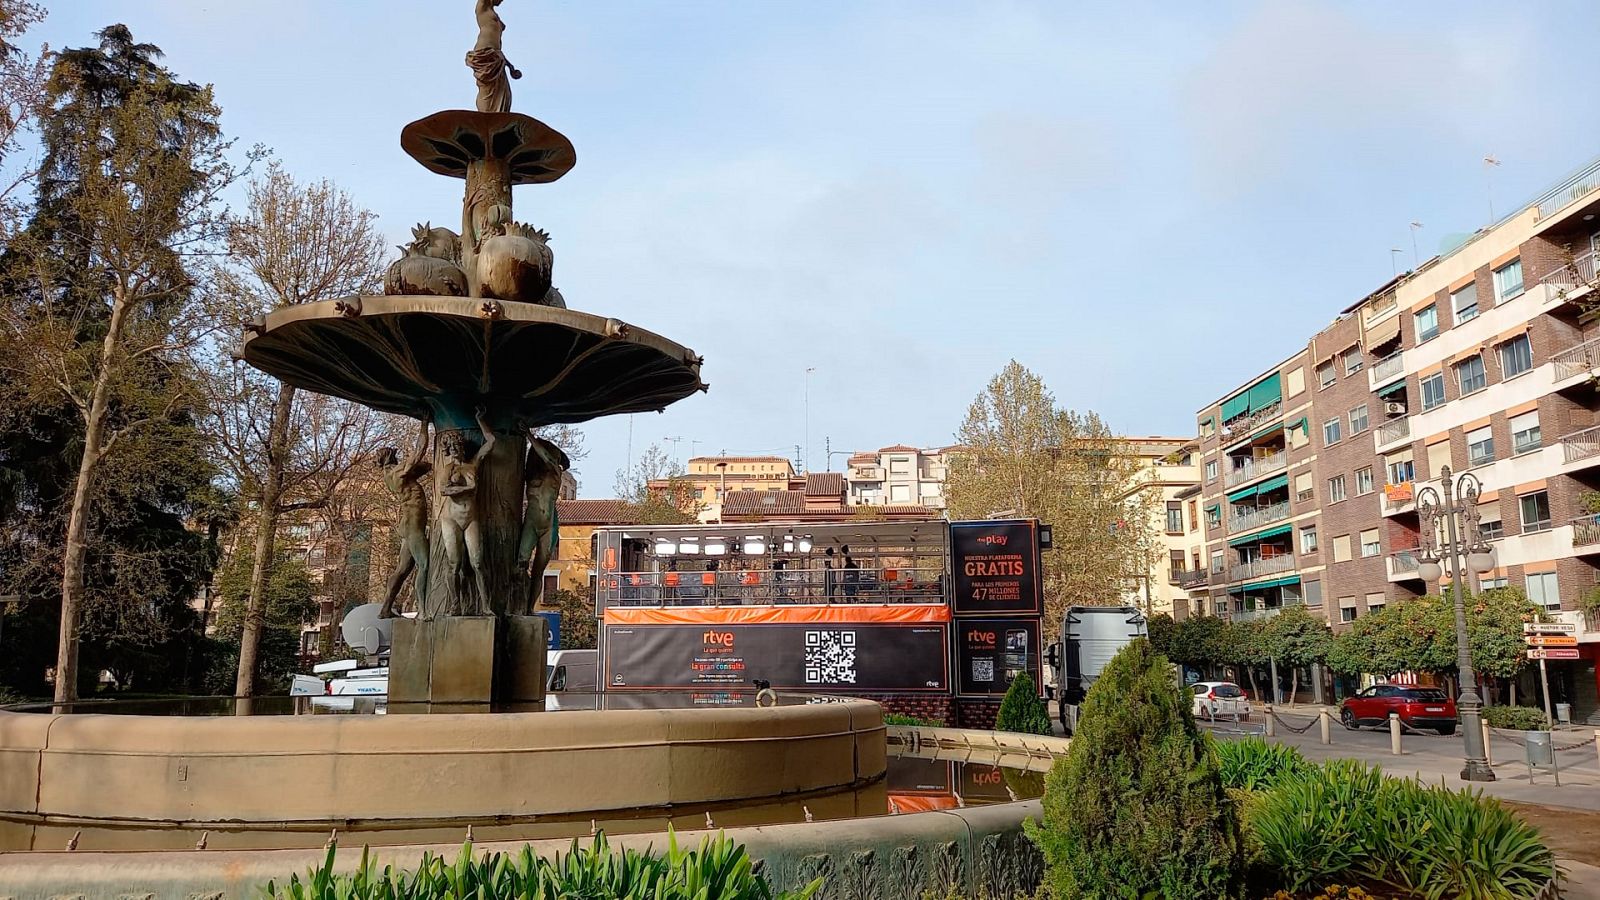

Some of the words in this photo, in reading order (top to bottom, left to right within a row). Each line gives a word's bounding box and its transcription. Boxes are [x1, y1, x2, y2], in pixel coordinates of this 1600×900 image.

[986, 535, 1008, 546] play
[964, 560, 1024, 577] GRATIS
[971, 588, 988, 601] 47
[703, 630, 734, 647] rtve
[968, 630, 996, 644] rtve
[715, 662, 745, 670] consulta
